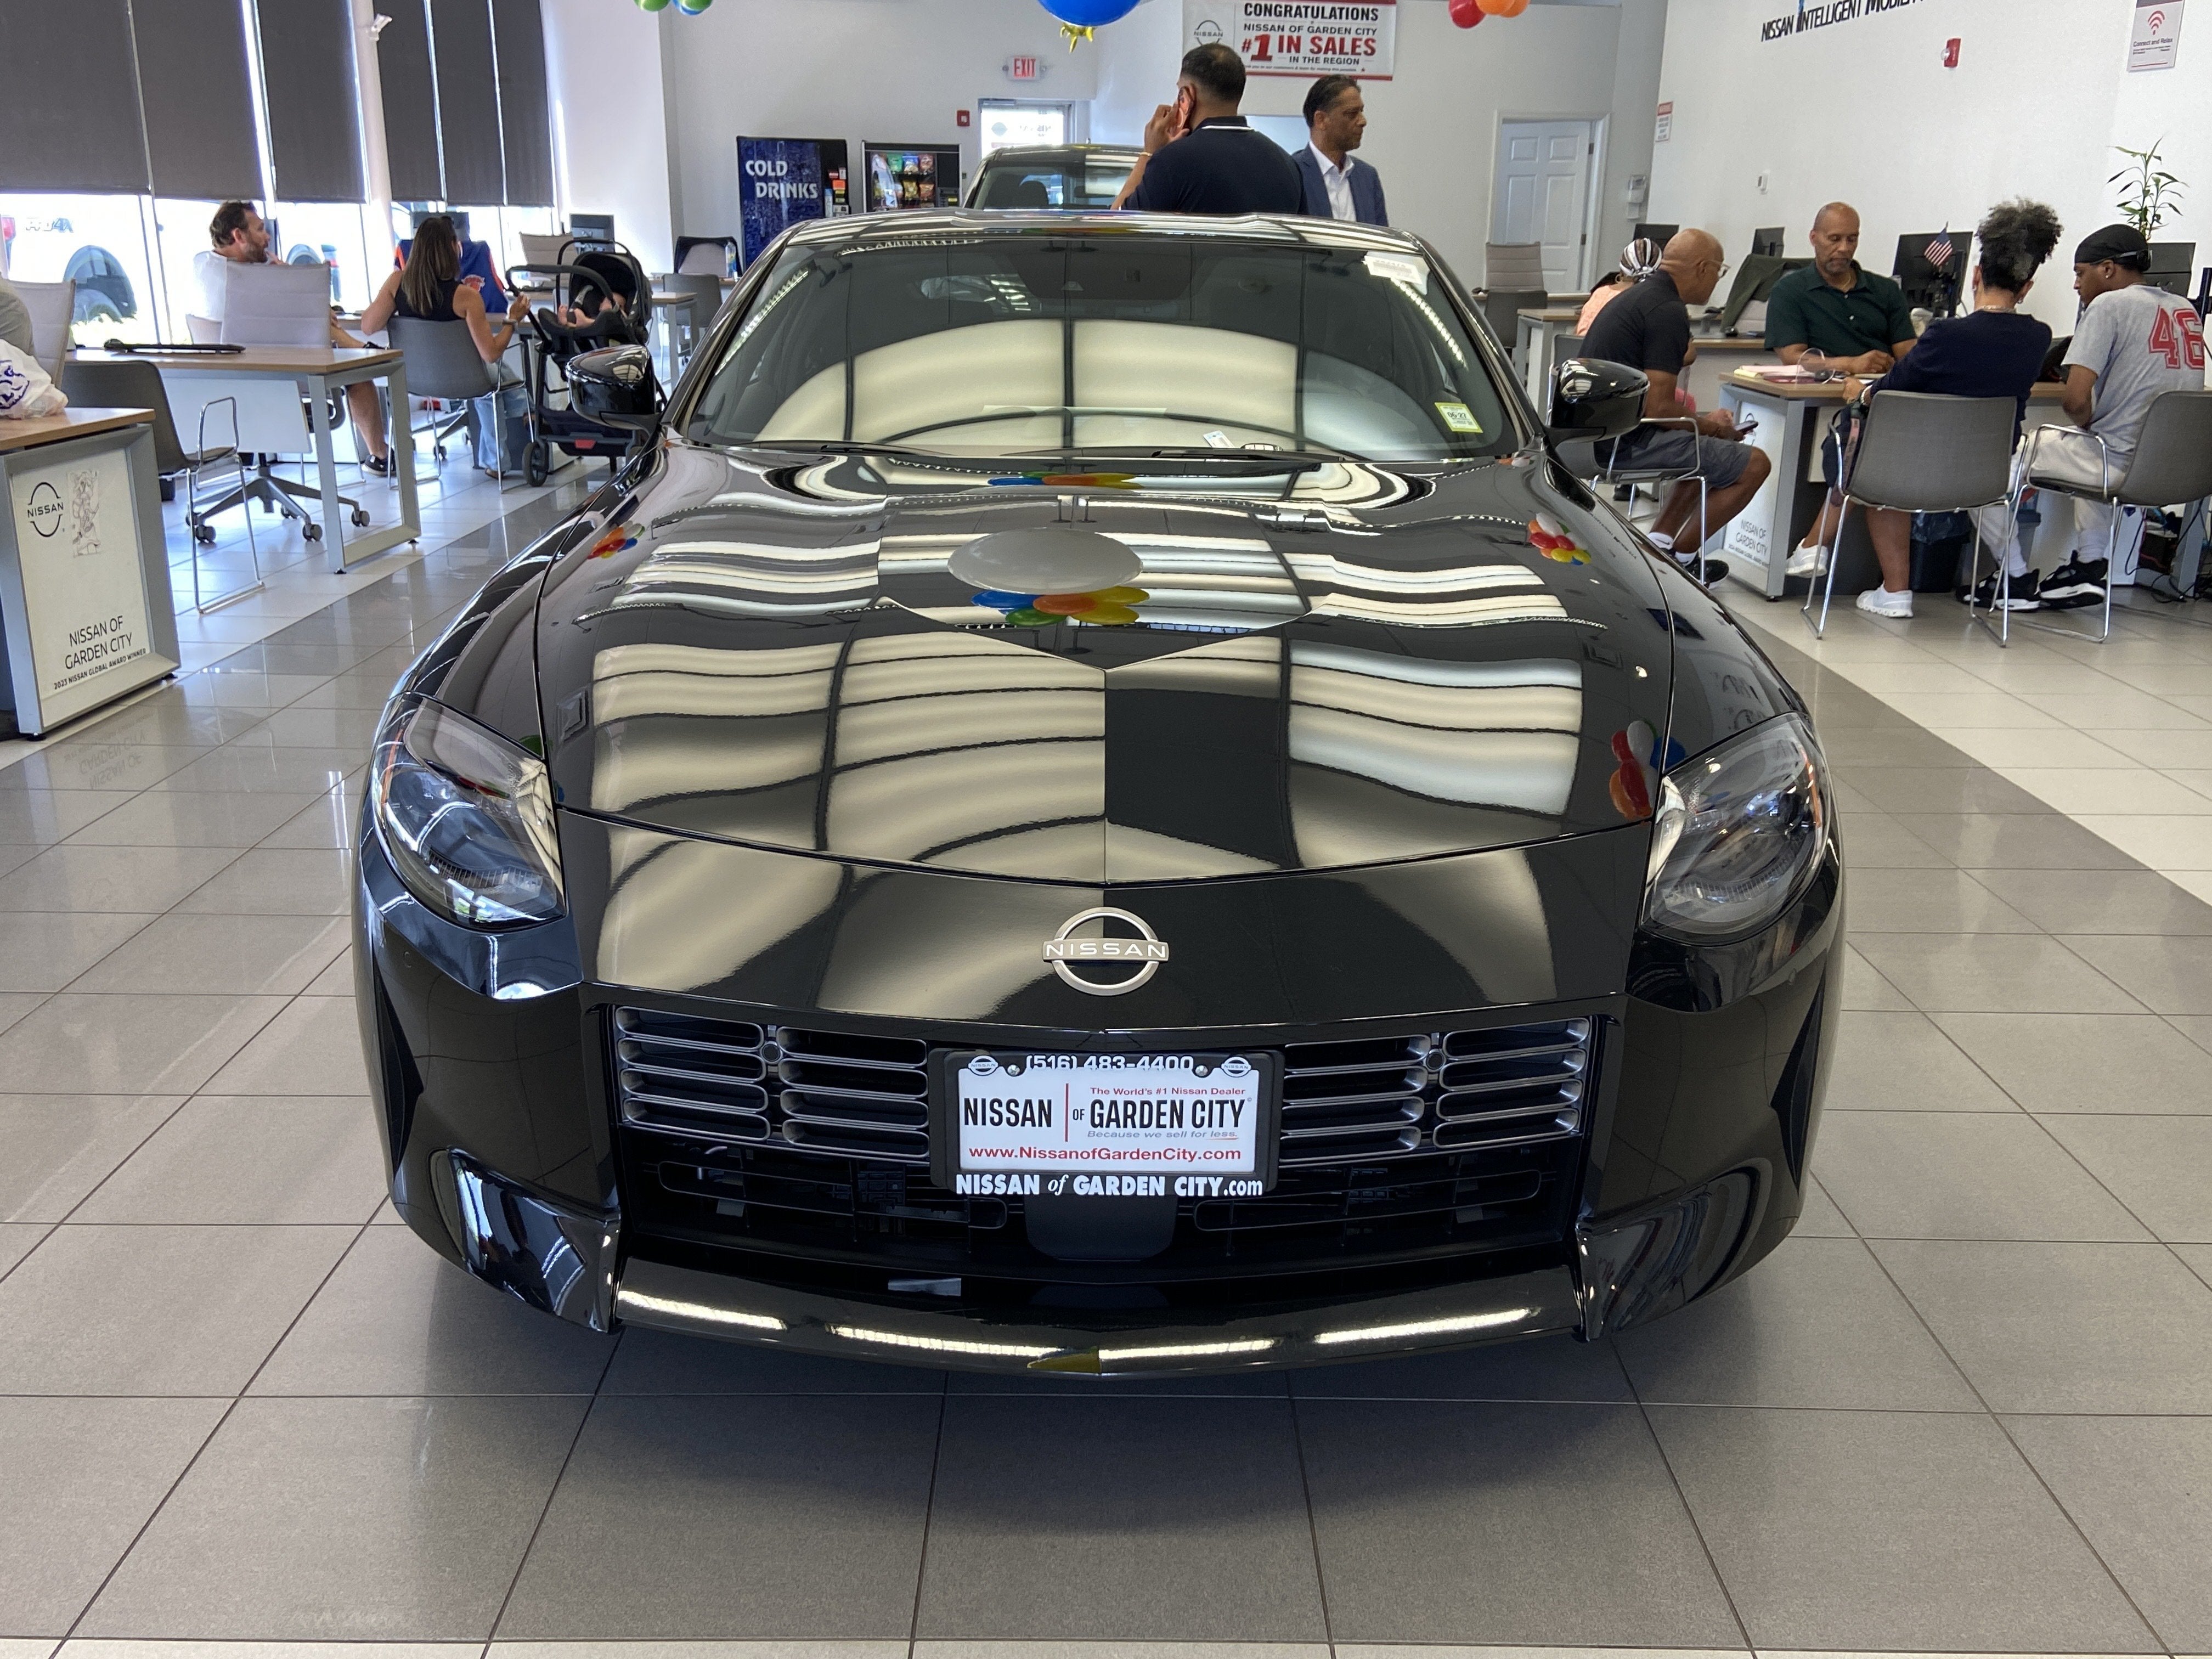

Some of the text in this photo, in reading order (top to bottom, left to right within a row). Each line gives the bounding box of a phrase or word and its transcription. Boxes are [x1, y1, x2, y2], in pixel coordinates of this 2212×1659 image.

[1244, 3, 1378, 21] CONGRATULATIONS
[1761, 15, 1794, 42] NISSAN
[1796, 0, 1861, 32] INTELLIGENT
[1244, 23, 1285, 33] NISSAN
[1307, 26, 1351, 35] GARDEN
[1242, 33, 1376, 61] #1 IN SALES
[1014, 58, 1036, 77] EXIT
[745, 160, 788, 177] COLD
[755, 182, 819, 200] DRINKS
[2148, 304, 2205, 370] 46
[27, 502, 64, 518] NISSAN
[69, 616, 123, 647] NISSAN OF
[65, 632, 132, 669] GARDEN CITY
[54, 648, 146, 690] 2023 NISSAN GLOBAL AWARD WINNER
[1046, 943, 1165, 958] NISSAN
[1026, 1055, 1194, 1070] (516) 483-4400
[1090, 1087, 1110, 1095] The
[1113, 1087, 1152, 1096] World's
[964, 1098, 1245, 1129] NISSAN OF GARDEN CITY
[969, 1147, 1241, 1162] www.NissanofGardenCity.com
[956, 1174, 1262, 1197] NISSAN of GARDEN CITY.com
